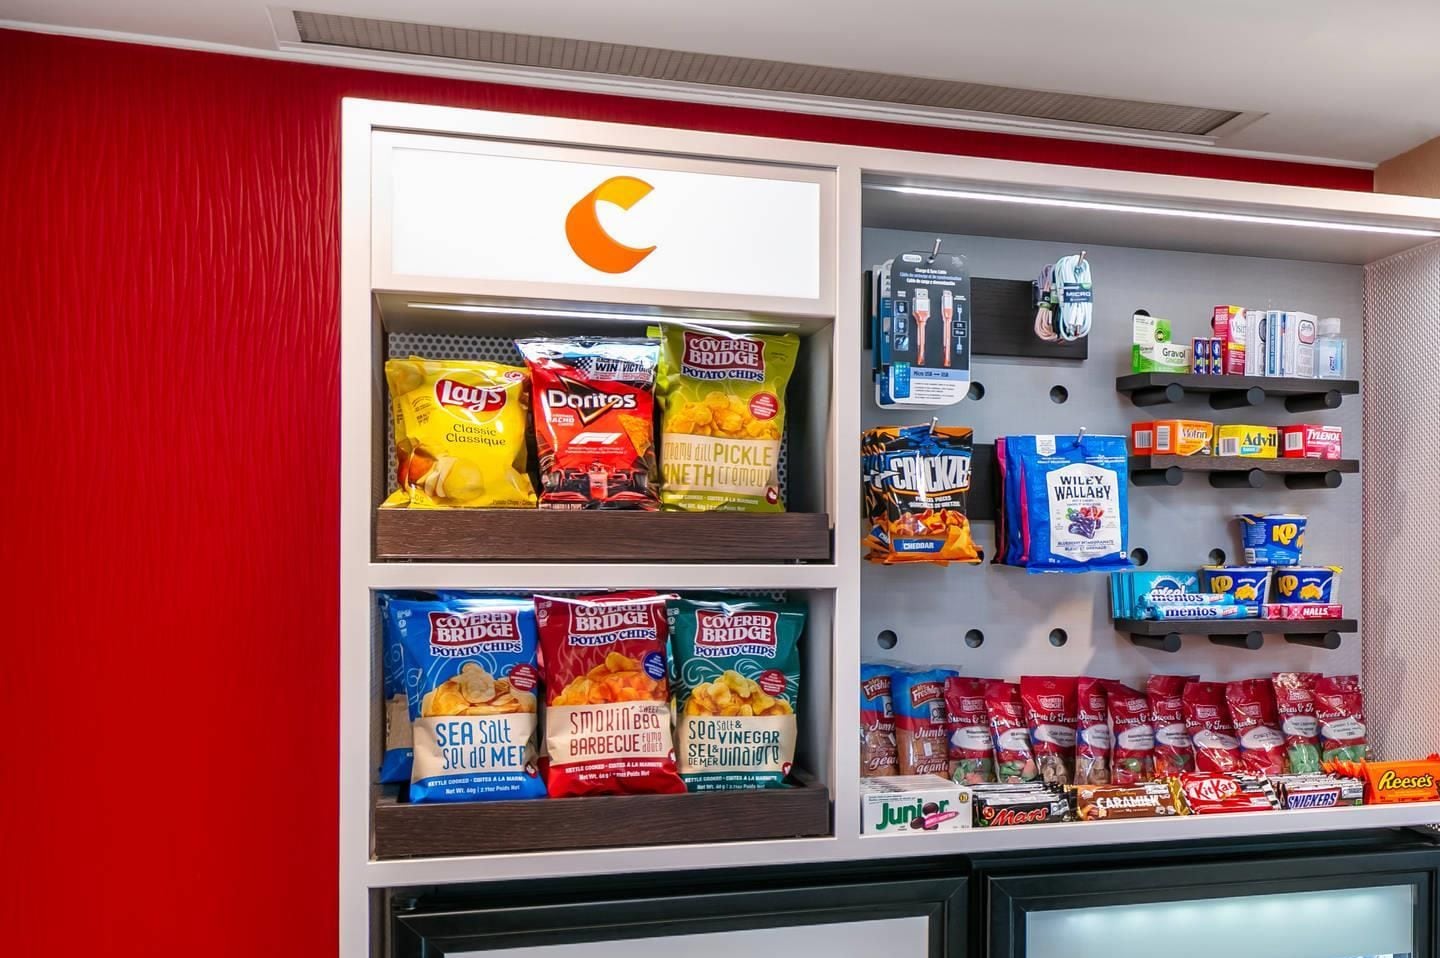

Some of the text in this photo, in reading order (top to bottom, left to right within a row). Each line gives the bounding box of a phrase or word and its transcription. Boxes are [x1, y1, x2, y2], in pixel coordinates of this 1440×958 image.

[690, 338, 759, 352] COVERED
[689, 350, 759, 367] BRIDGE
[1162, 347, 1186, 359] Gravol
[596, 363, 618, 372] WIN
[683, 367, 764, 382] POTATO CHIPS
[441, 380, 503, 413] Lays
[548, 390, 637, 409] Doritos
[453, 423, 497, 437] Classic
[1181, 426, 1208, 440] Motrin
[1307, 427, 1341, 441] TYLENOL
[446, 432, 506, 447] Classique
[1243, 431, 1277, 448] Advil
[713, 442, 773, 467] PICKLE
[1060, 475, 1104, 486] WILEY
[1054, 485, 1111, 502] WALLABY
[903, 541, 934, 550] CHEDDAR
[1152, 593, 1204, 603] mentos
[575, 604, 649, 618] COVERED
[1165, 606, 1217, 617] mentos
[1303, 607, 1329, 616] HALLS
[436, 613, 513, 628] COVERED
[576, 611, 649, 632] BRIDGE
[702, 615, 771, 628] COVERED
[437, 624, 514, 643] BRIDGE
[570, 628, 657, 646] POTATO CHIPS
[702, 626, 771, 642] BRIDGE
[431, 641, 523, 658] POTATO CHIPS
[695, 645, 775, 658] POTATO CHIPS
[633, 713, 660, 730] BBQ
[735, 720, 742, 729] &
[436, 722, 474, 748] SEA
[718, 730, 780, 745] VINEGAR
[570, 734, 640, 757] BARBECUE
[689, 743, 713, 758] SEL
[689, 757, 718, 767] DE MER
[1378, 770, 1434, 791] Reese's
[1189, 779, 1235, 799] KitKat
[1096, 794, 1161, 809] CARAMILK
[1288, 792, 1337, 809] SNICKERS
[990, 806, 1049, 826] Mars
